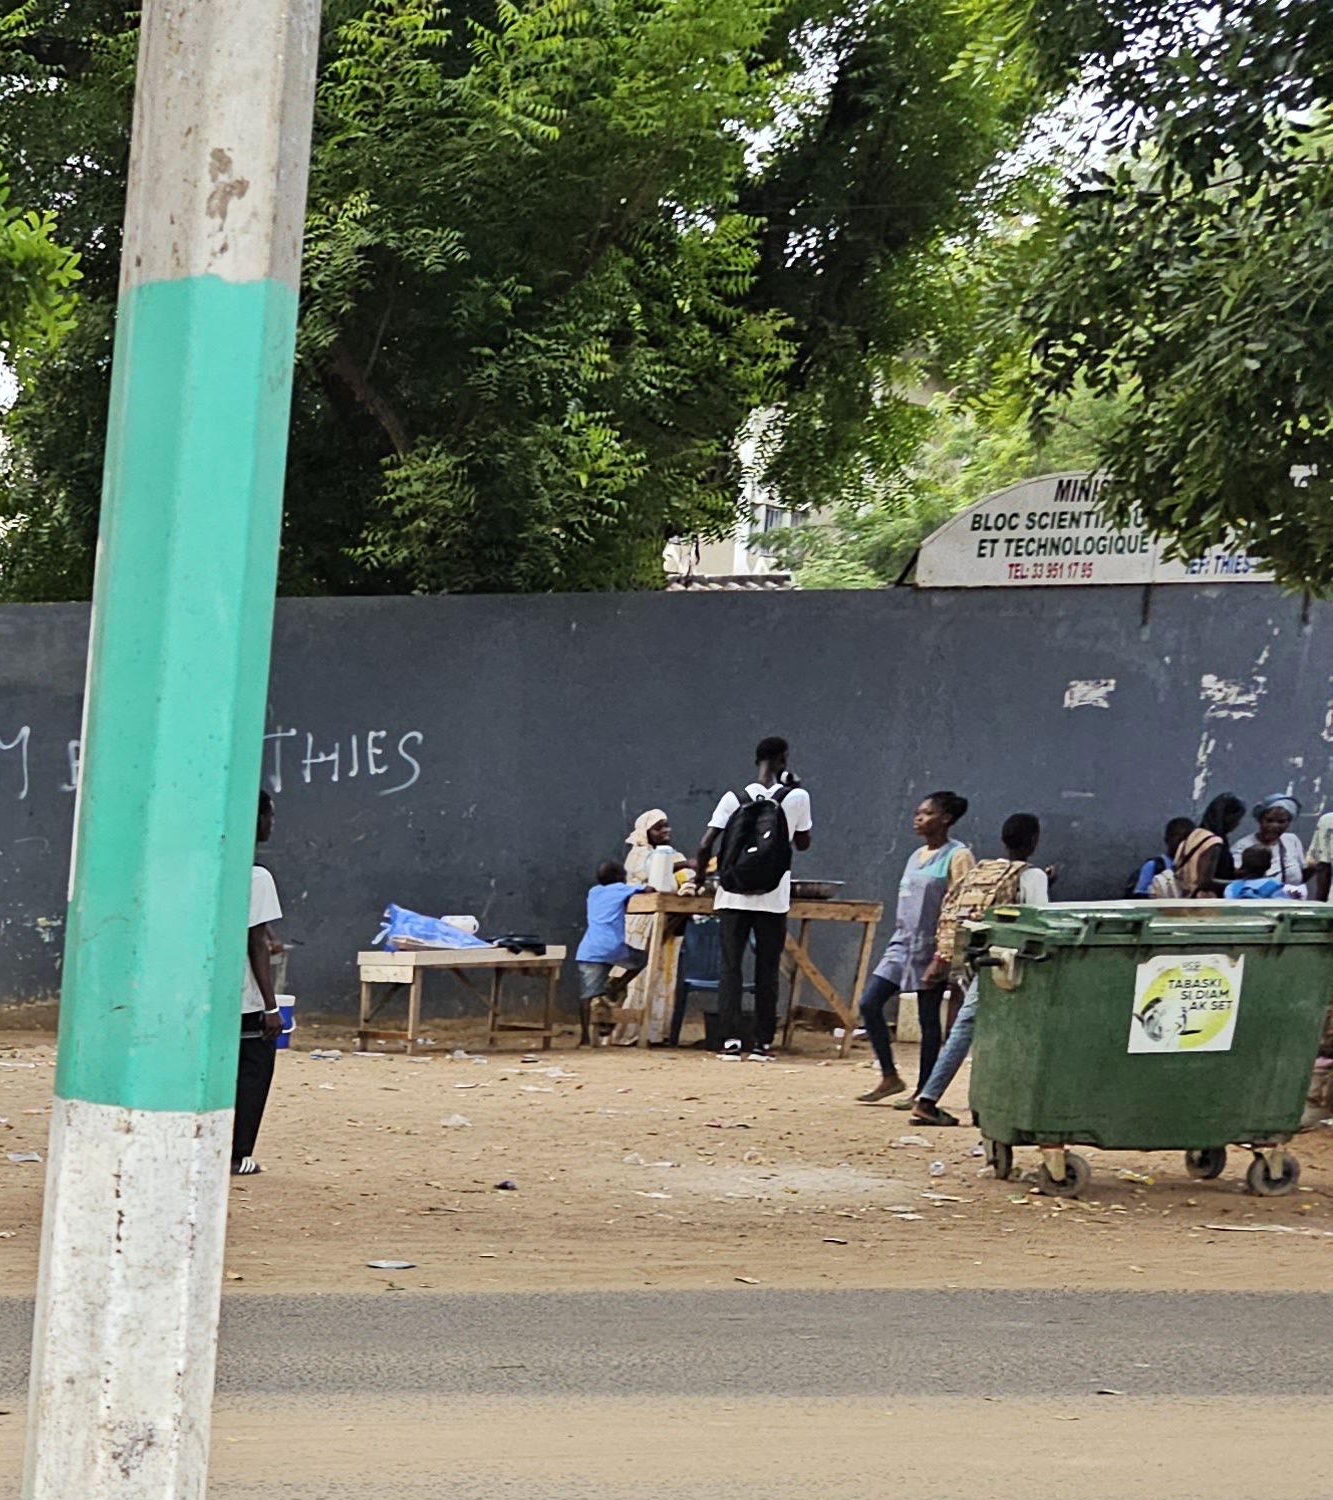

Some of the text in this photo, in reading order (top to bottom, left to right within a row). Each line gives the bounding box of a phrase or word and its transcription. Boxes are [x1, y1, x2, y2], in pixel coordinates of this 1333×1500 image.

[970, 512, 1020, 531] BLOC
[977, 534, 1150, 558] ET TECHNOLOGIQUE
[1008, 563, 1028, 579] TEL:
[1031, 562, 1044, 579] 33
[1067, 562, 1080, 579] 17
[261, 726, 425, 797] THIES
[1167, 978, 1222, 990] TABASKI
[1195, 989, 1230, 1000] DIAM
[1189, 1000, 1233, 1011] AK SET
